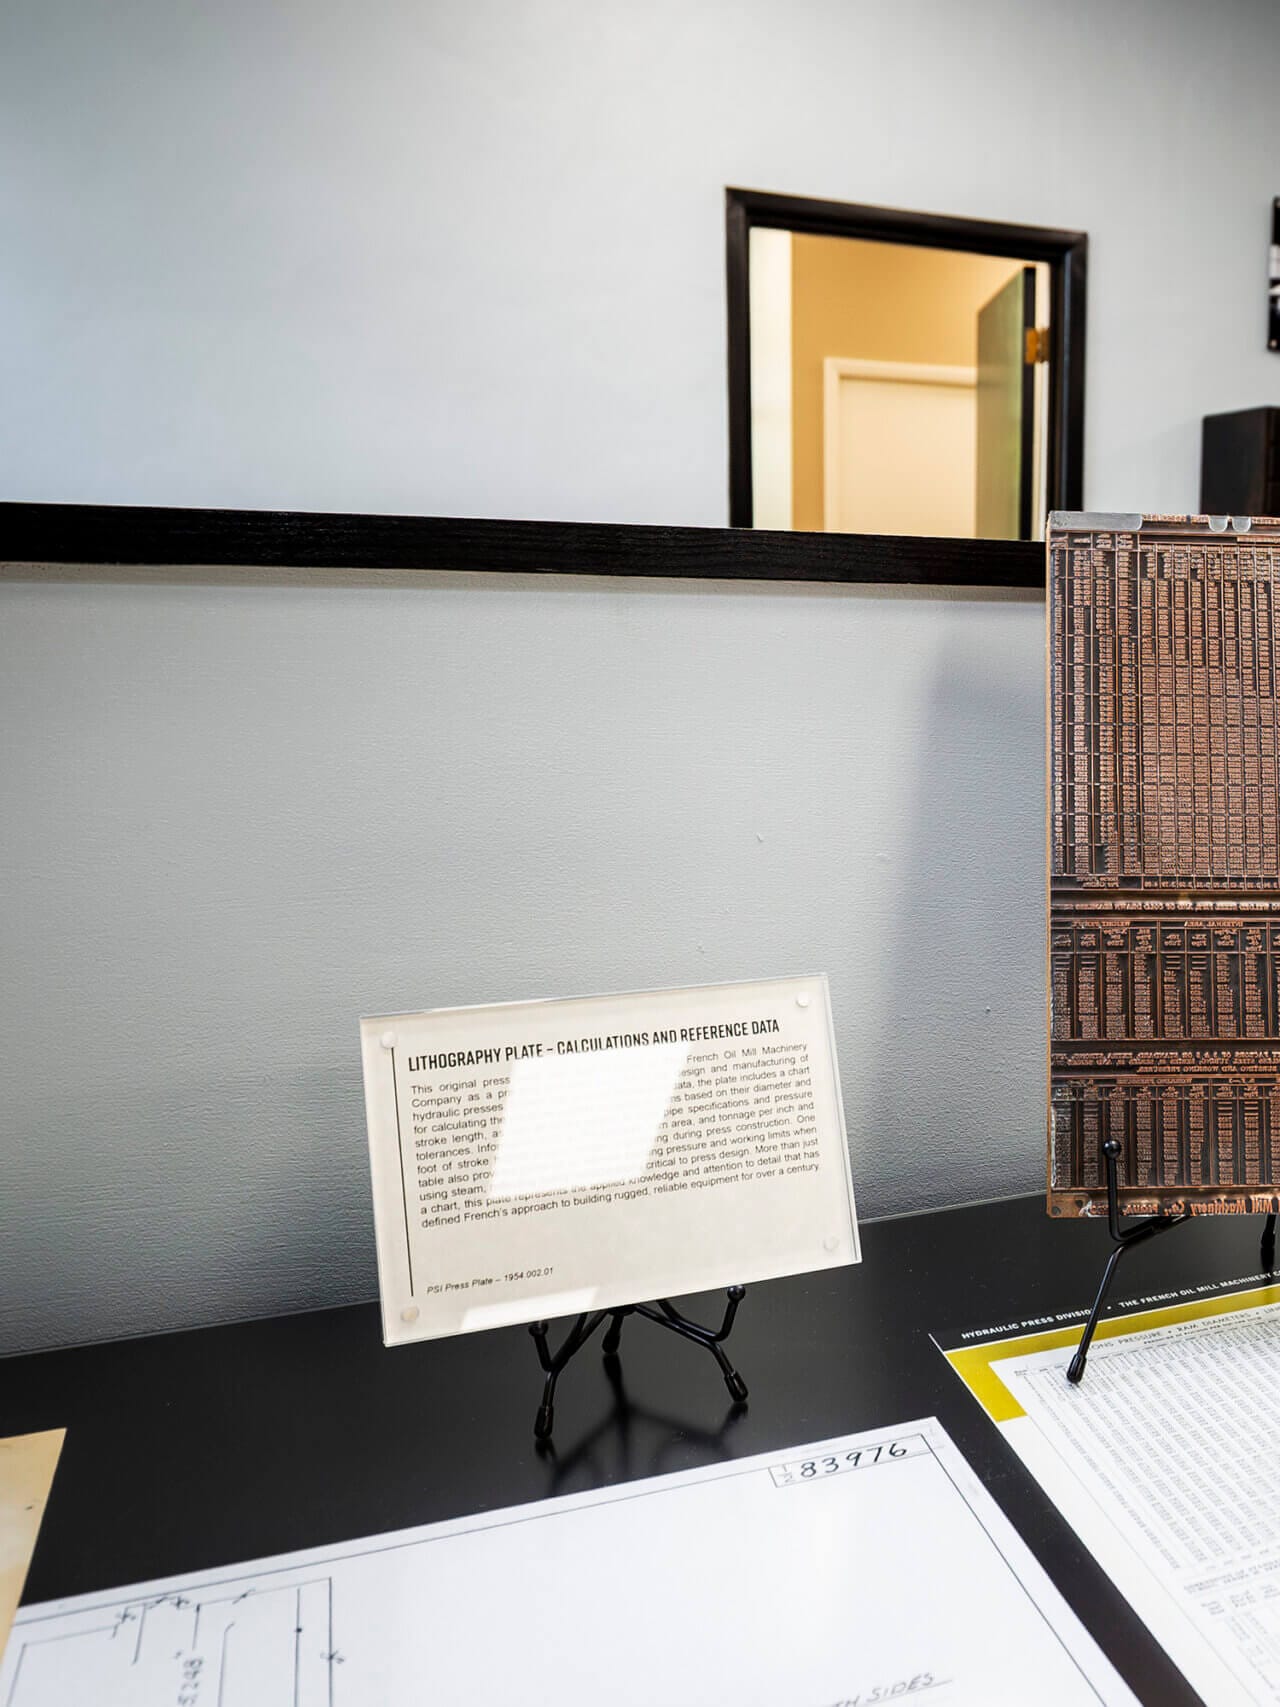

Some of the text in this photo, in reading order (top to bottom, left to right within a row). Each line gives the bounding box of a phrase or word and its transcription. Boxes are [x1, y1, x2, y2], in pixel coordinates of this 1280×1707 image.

[408, 1048, 501, 1071] LITHOGRAPHY
[505, 1043, 543, 1061] PLATE
[557, 1033, 649, 1055] CALCULATIONS
[652, 1030, 677, 1045] AND
[680, 1023, 748, 1042] REFERENCE
[752, 1020, 780, 1035] DATA
[411, 1045, 807, 1094] This original press French Oil Mill Machinery
[412, 1096, 462, 1108] Company
[680, 1067, 705, 1077] esign
[711, 1064, 727, 1073] and
[733, 1057, 796, 1070] manufacturing
[800, 1055, 808, 1063] of
[413, 1108, 460, 1122] hydraulic
[464, 1105, 503, 1117] presses
[698, 1079, 712, 1087] the
[715, 1076, 737, 1087] plate
[740, 1072, 776, 1082] includes
[788, 1067, 809, 1076] chart
[414, 1126, 427, 1134] for
[431, 1119, 487, 1132] calculating
[685, 1090, 712, 1101] based
[730, 1086, 750, 1095] their
[753, 1082, 792, 1092] diameter
[795, 1078, 811, 1087] and
[415, 1136, 447, 1147] stroke
[688, 1100, 749, 1114] specifications
[754, 1095, 770, 1105] and
[774, 1092, 812, 1104] pressure
[699, 1114, 716, 1124] and
[719, 1112, 756, 1121] tonnage
[759, 1109, 773, 1118] per
[776, 1104, 794, 1114] inch
[798, 1102, 814, 1111] and
[417, 1163, 437, 1174] foot
[442, 1161, 452, 1171] of
[458, 1157, 488, 1169] stroke
[673, 1130, 702, 1140] during
[707, 1127, 731, 1138] press
[797, 1115, 815, 1123] One
[418, 1177, 444, 1187] table
[448, 1174, 469, 1183] also
[667, 1143, 707, 1155] pressure
[710, 1138, 727, 1147] and
[730, 1134, 765, 1145] working
[768, 1130, 790, 1139] limits
[793, 1127, 817, 1136] when
[420, 1191, 448, 1201] using
[646, 1157, 675, 1169] critical
[679, 1156, 688, 1164] to
[691, 1154, 716, 1165] press
[755, 1145, 777, 1153] More
[781, 1142, 799, 1150] than
[803, 1138, 818, 1149] just
[422, 1214, 460, 1228] defined
[511, 1200, 557, 1216] approach
[561, 1199, 570, 1207] to
[574, 1194, 611, 1205] building
[654, 1182, 687, 1193] reliable
[691, 1173, 739, 1189] equipment
[741, 1172, 752, 1180] for
[757, 1170, 775, 1178] over
[787, 1164, 819, 1173] century
[465, 1198, 482, 1208] this
[683, 1166, 699, 1176] and
[703, 1162, 742, 1173] attention
[746, 1159, 754, 1167] to
[757, 1155, 781, 1165] detail
[784, 1152, 801, 1162] that
[804, 1151, 819, 1159] has
[427, 1285, 443, 1294] PSI
[445, 1282, 469, 1291] Press
[472, 1277, 493, 1286] Plate
[961, 1322, 1019, 1339] HYDRAULIC
[1020, 1315, 1054, 1327] PRESS
[1055, 1308, 1093, 1320] DIVISIO
[1118, 1298, 1139, 1308] THE
[1140, 1291, 1178, 1303] FRENCH
[1179, 1287, 1196, 1296] OIL
[1196, 1282, 1219, 1292] MILL
[1219, 1272, 1270, 1287] MACHINERY
[800, 1443, 907, 1478] 83976
[866, 1672, 933, 1702] SIDES
